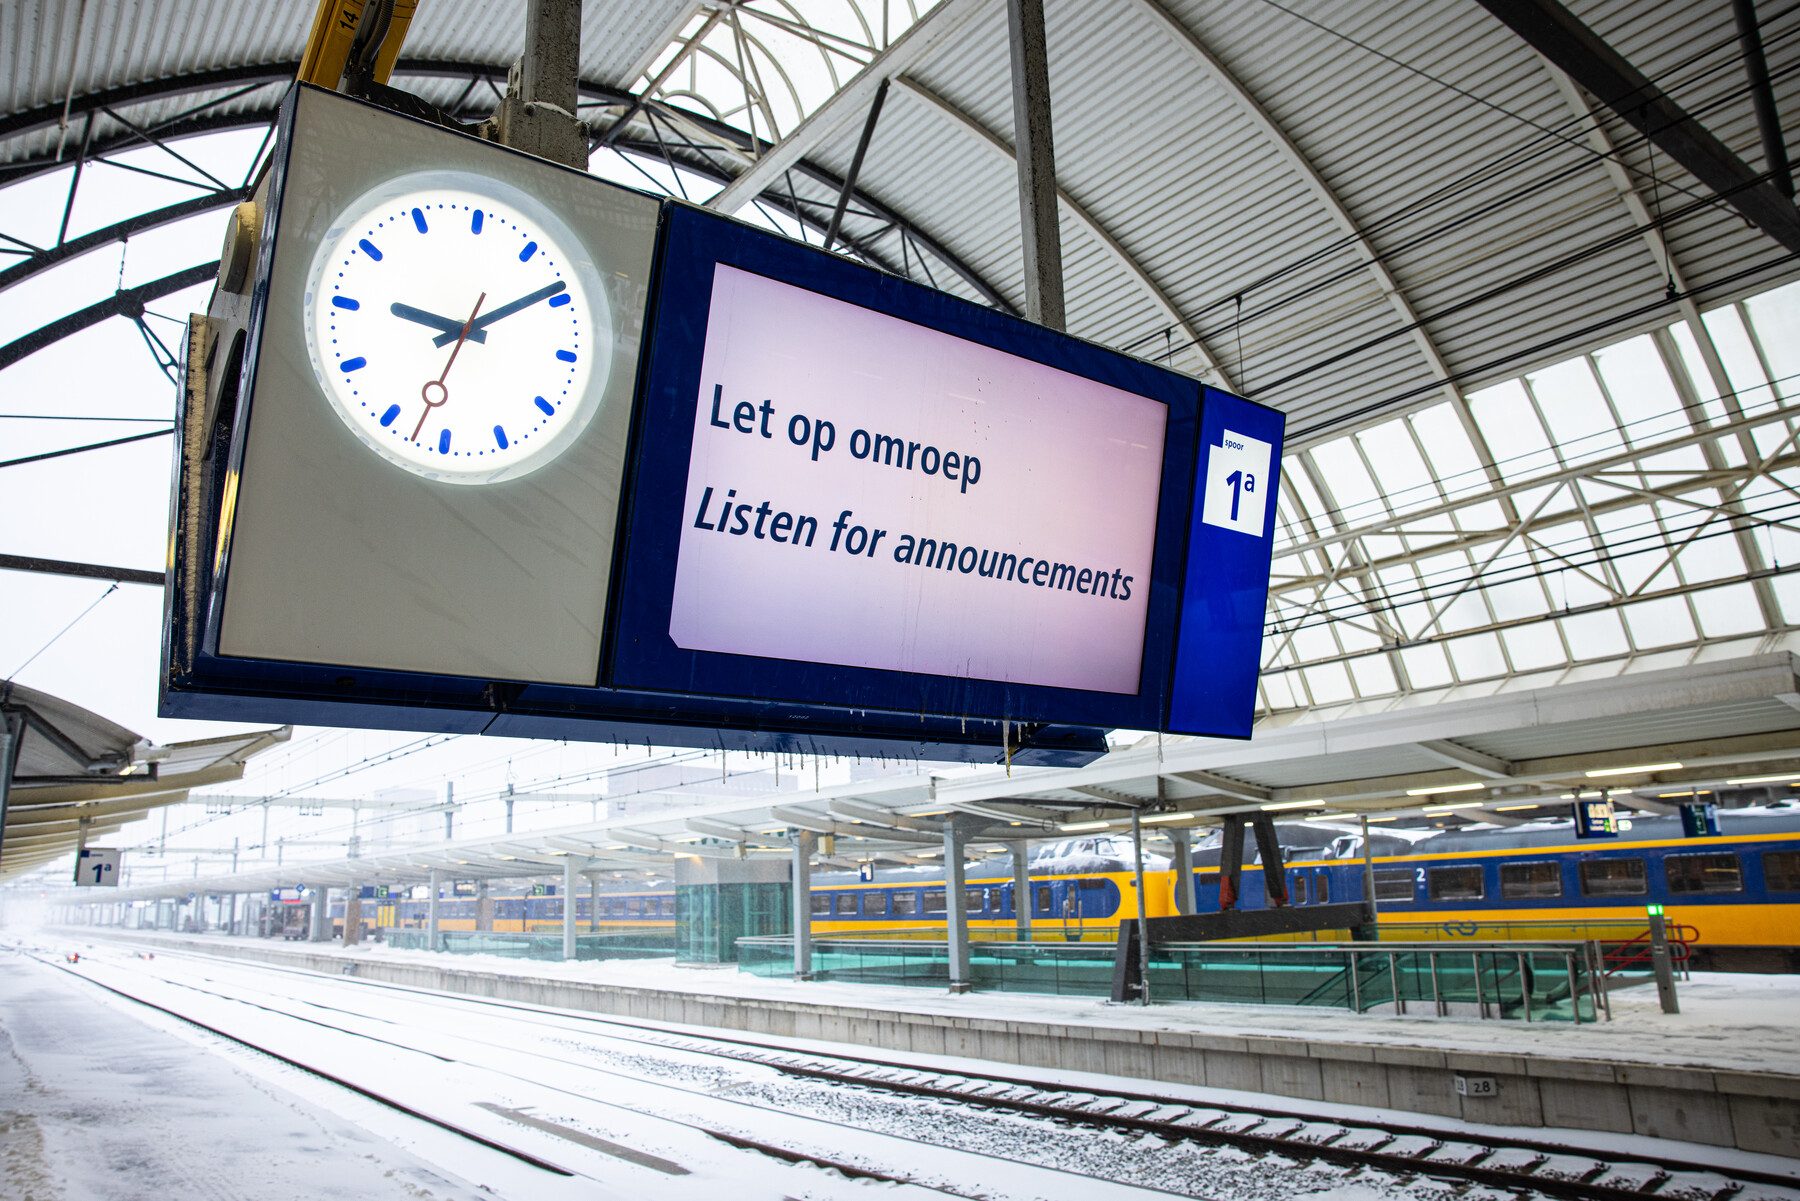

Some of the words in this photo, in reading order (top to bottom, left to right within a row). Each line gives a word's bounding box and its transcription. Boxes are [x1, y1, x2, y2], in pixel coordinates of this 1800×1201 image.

[339, 9, 359, 31] 14
[710, 383, 776, 439] Let
[787, 414, 836, 462] op
[849, 428, 982, 494] omroep
[1224, 439, 1245, 451] spoor
[693, 486, 818, 548] Listen
[829, 509, 887, 559] for
[893, 533, 1135, 602] announcements
[1416, 867, 1426, 882] 2
[983, 888, 990, 899] 2
[1473, 1080, 1491, 1094] 28
